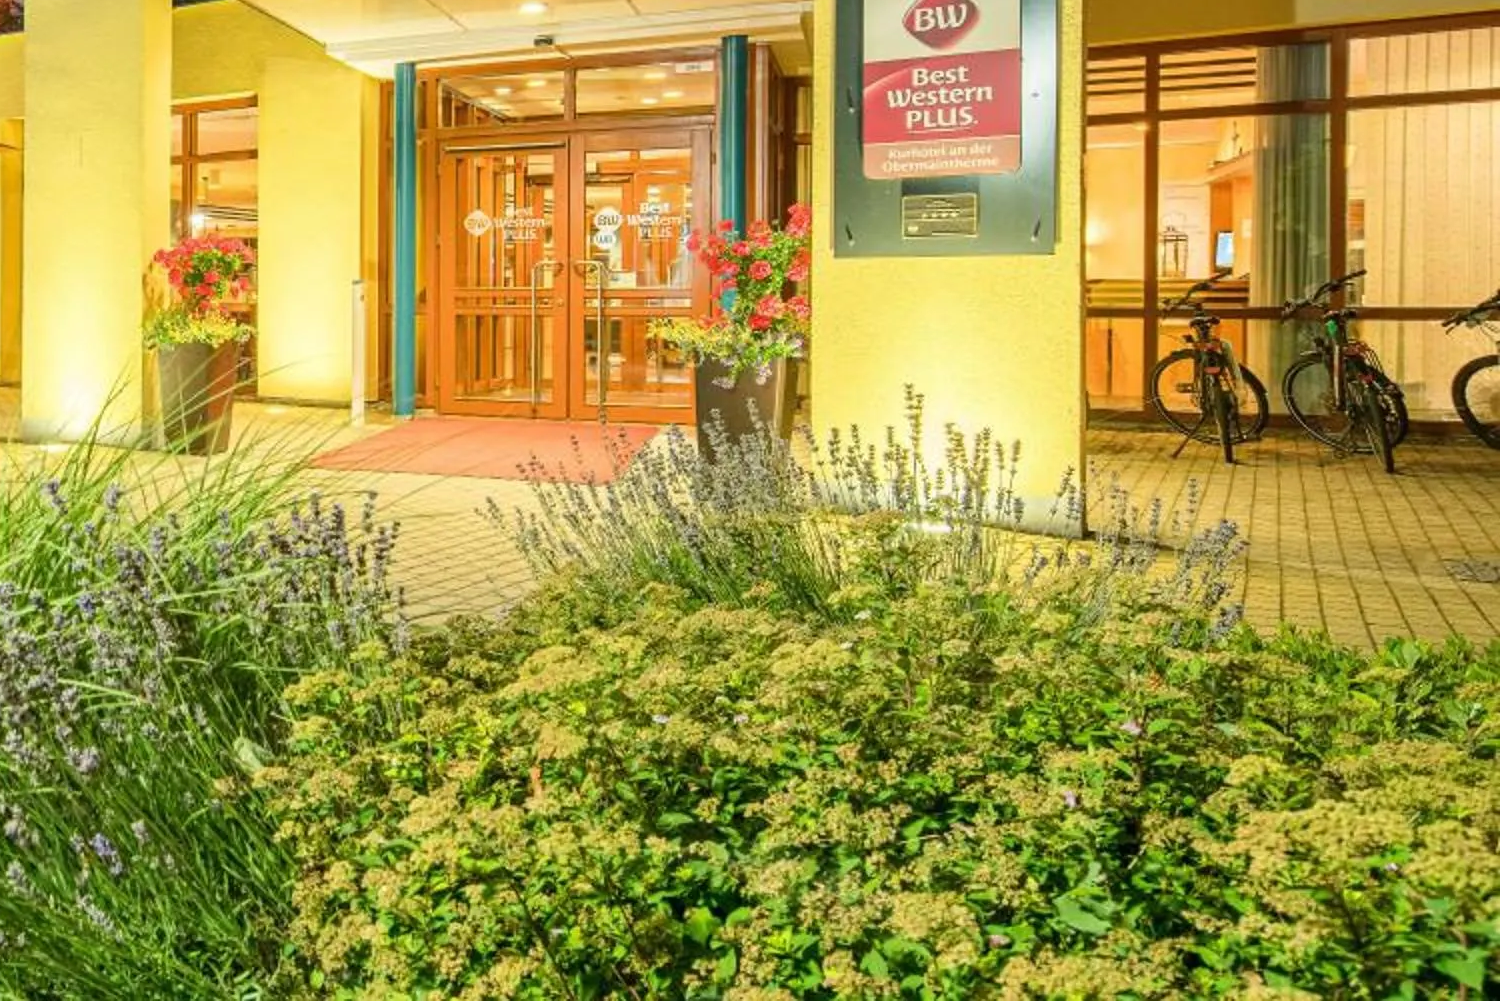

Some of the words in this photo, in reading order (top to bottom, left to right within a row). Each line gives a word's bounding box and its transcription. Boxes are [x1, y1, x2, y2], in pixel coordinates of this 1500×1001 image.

[914, 2, 967, 33] BW
[912, 65, 969, 86] Best
[887, 83, 994, 108] Western
[888, 143, 946, 160] Kurhotel
[949, 145, 966, 156] an
[969, 142, 992, 155] der
[882, 157, 998, 173] Obermaintherme
